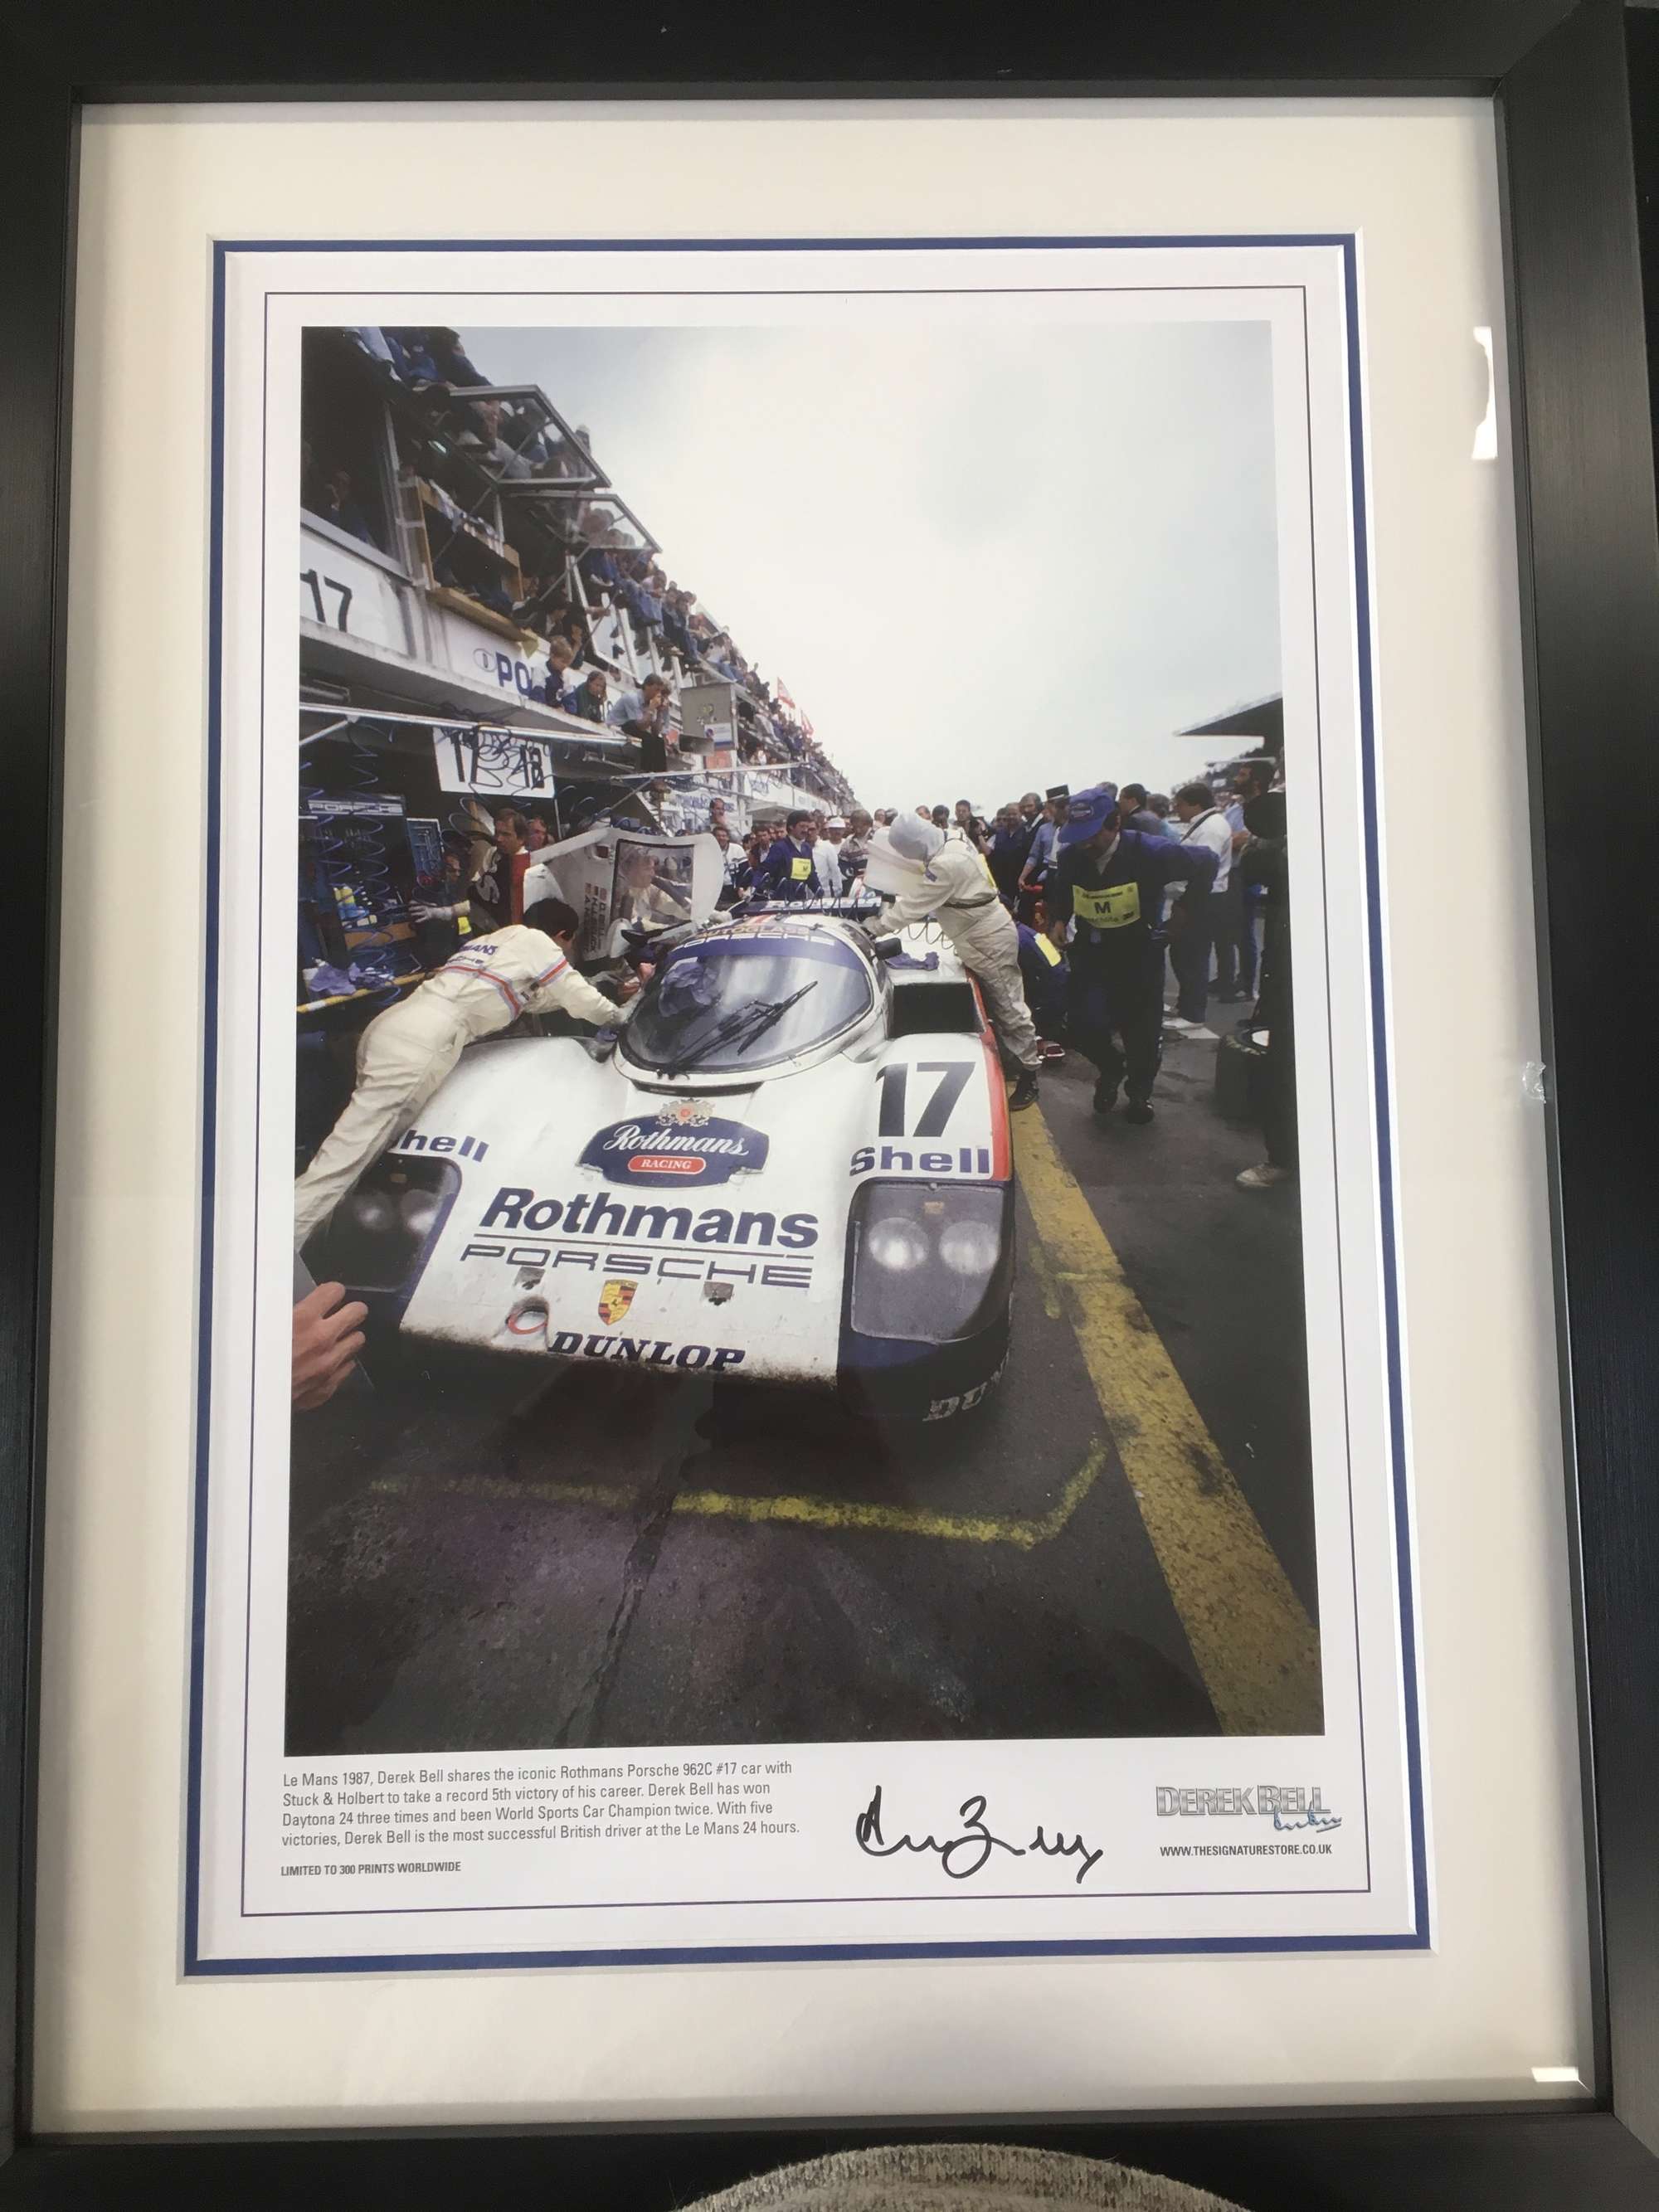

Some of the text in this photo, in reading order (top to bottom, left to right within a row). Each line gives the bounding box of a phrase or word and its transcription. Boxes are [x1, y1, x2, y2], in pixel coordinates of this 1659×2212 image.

[299, 569, 353, 633] 17
[1093, 901, 1112, 915] M
[876, 1062, 976, 1138] 17
[399, 1129, 489, 1163] hell
[603, 1124, 750, 1156] Rothmans
[640, 1159, 692, 1170] RACING
[849, 1145, 991, 1176] Shell
[478, 1187, 820, 1248] Rothmans
[460, 1244, 812, 1288] PORSCHE
[547, 1331, 746, 1372] DUNLOP
[283, 1760, 792, 1787] Le Mans 1987, Derek Bell shares the iconic Rothmans Porsche 962C #17 car with
[282, 1782, 771, 1807] Stuck & Holbert to take a record 5th victory of his career. Derek Bell has won
[1155, 1784, 1331, 1816] DEREK BELL
[282, 1801, 773, 1830] Daytona 24 three times and been World Sports Car Champion twice. With five
[281, 1820, 800, 1847] victories, Derek Bell is the most successful British driver at the Le Mans 24 hours.
[1160, 1844, 1333, 1857] WWW.THESIGNATURESTORE.CO.UK
[280, 1861, 462, 1877] LIMITED TO 300 PRINTS WORLDWIDE
